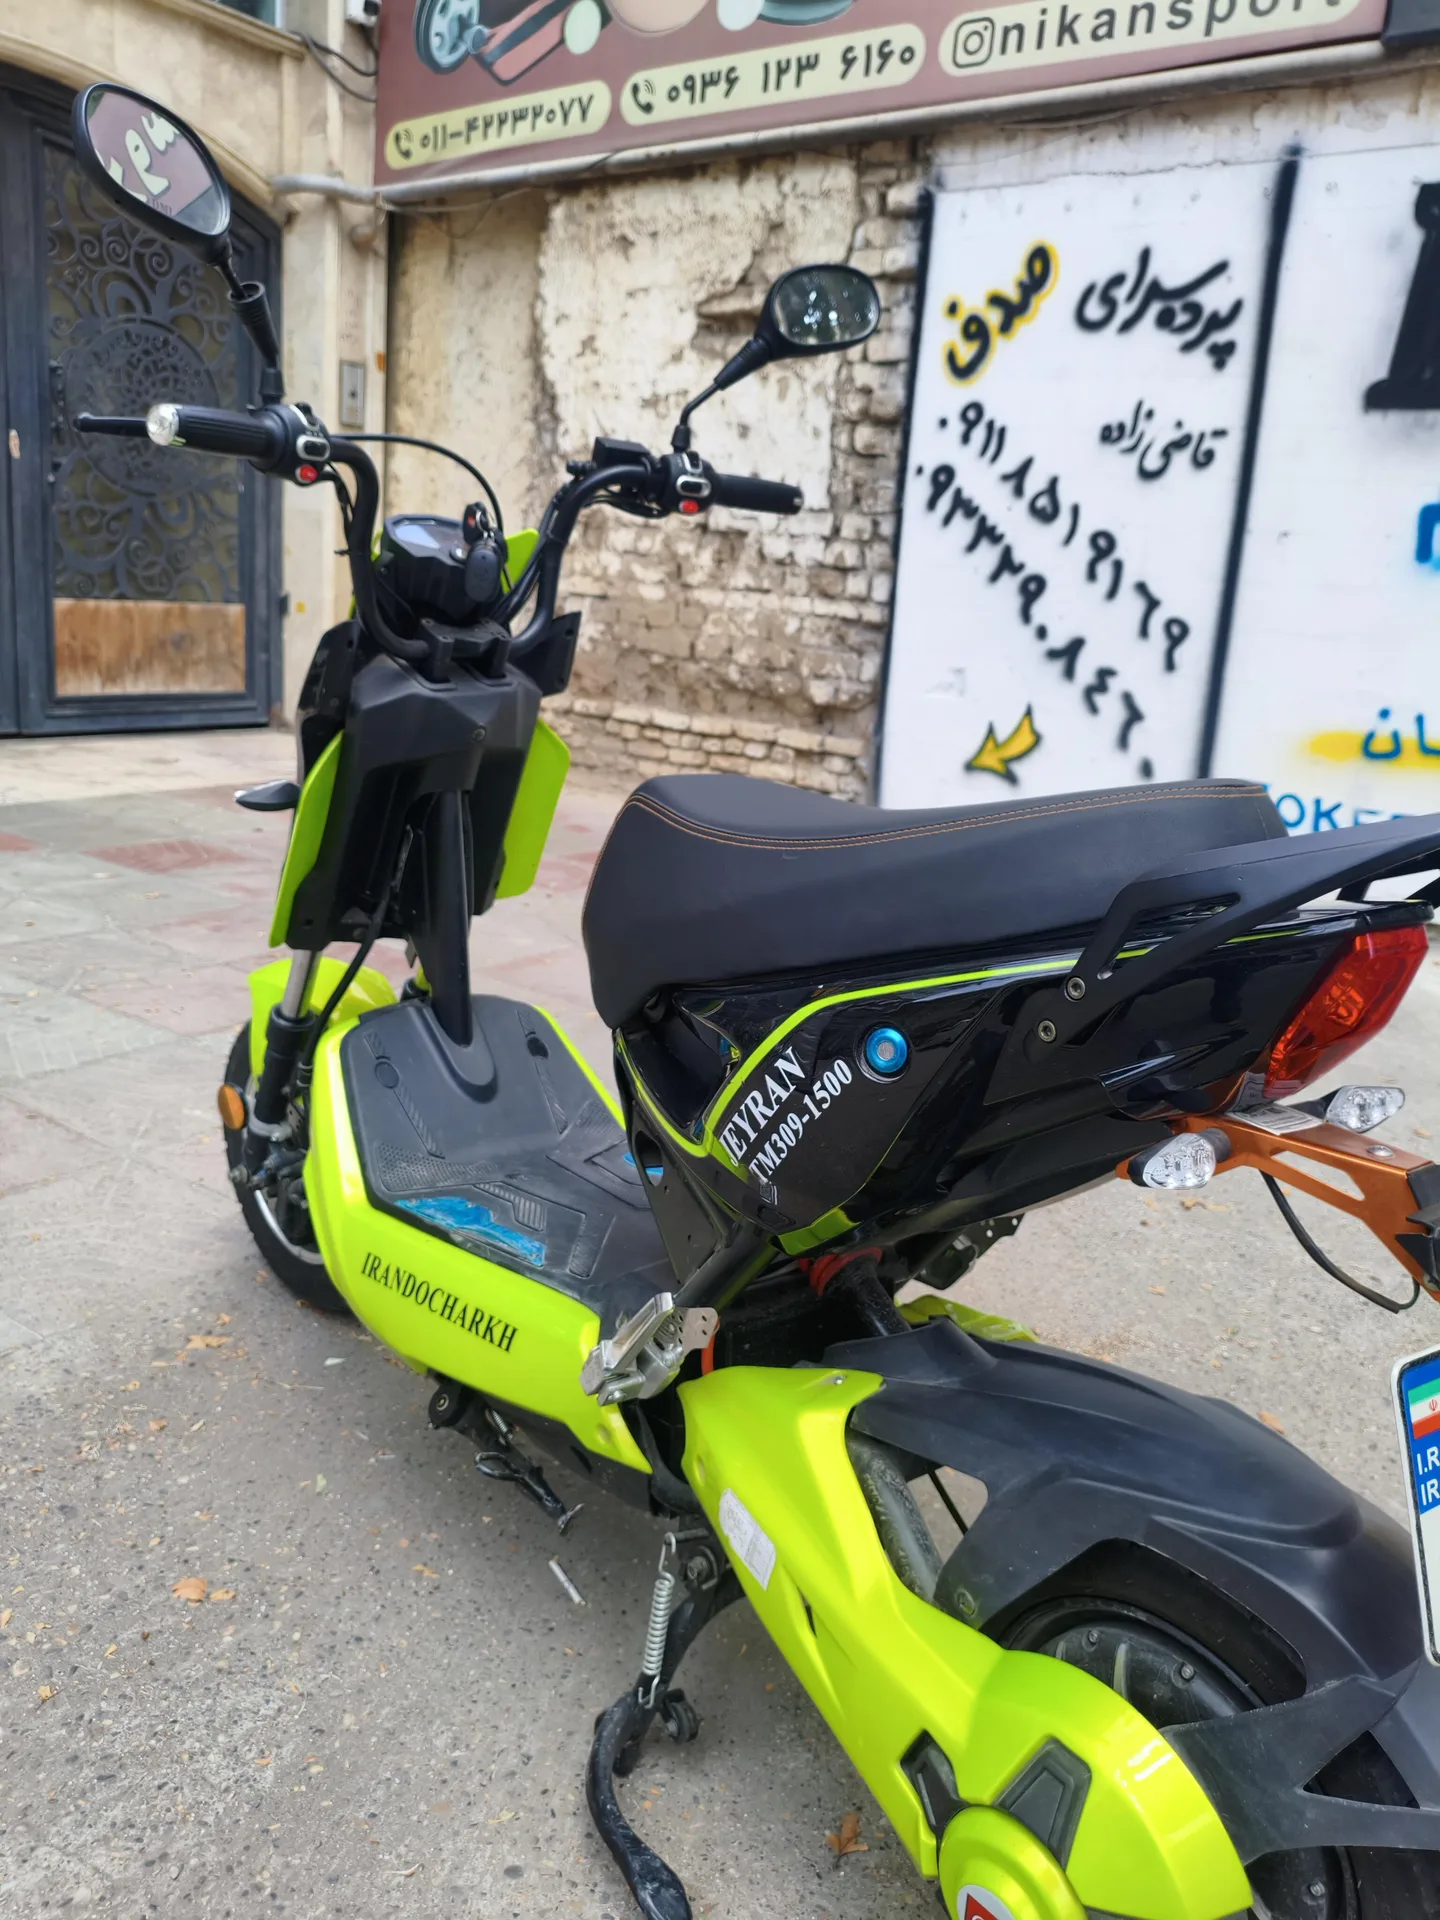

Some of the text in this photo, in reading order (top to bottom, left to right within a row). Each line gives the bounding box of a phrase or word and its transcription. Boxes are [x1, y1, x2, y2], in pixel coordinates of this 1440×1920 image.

[762, 51, 821, 93] ۱۲۳
[1000, 0, 1341, 57] nikanspo
[945, 241, 1058, 385] صدف
[718, 1046, 806, 1168] JEYRAN
[748, 1058, 853, 1185] TM309-1500
[361, 1252, 520, 1353] IRANDOCHARKH
